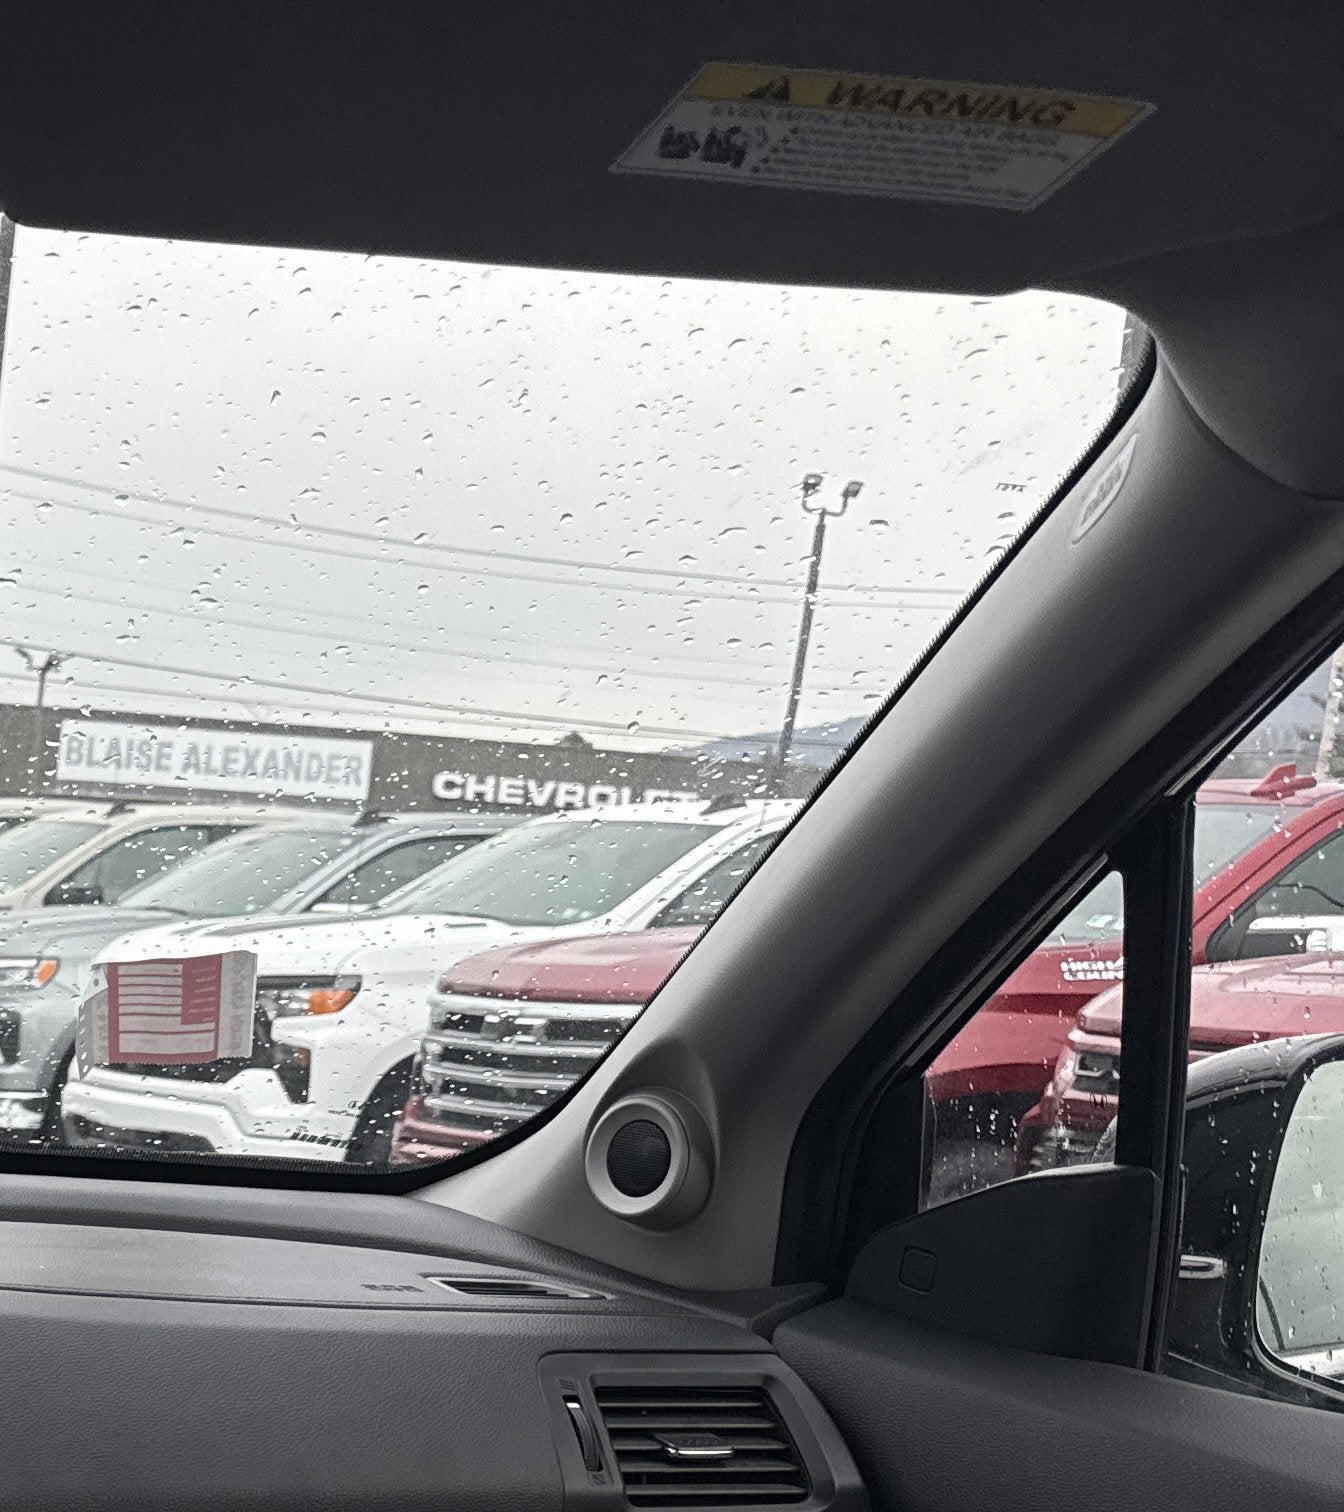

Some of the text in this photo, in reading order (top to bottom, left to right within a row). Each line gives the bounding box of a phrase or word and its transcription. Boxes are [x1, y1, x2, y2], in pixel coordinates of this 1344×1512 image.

[826, 79, 1076, 126] WARNING
[64, 734, 363, 786] BLAISE ALEXANDER
